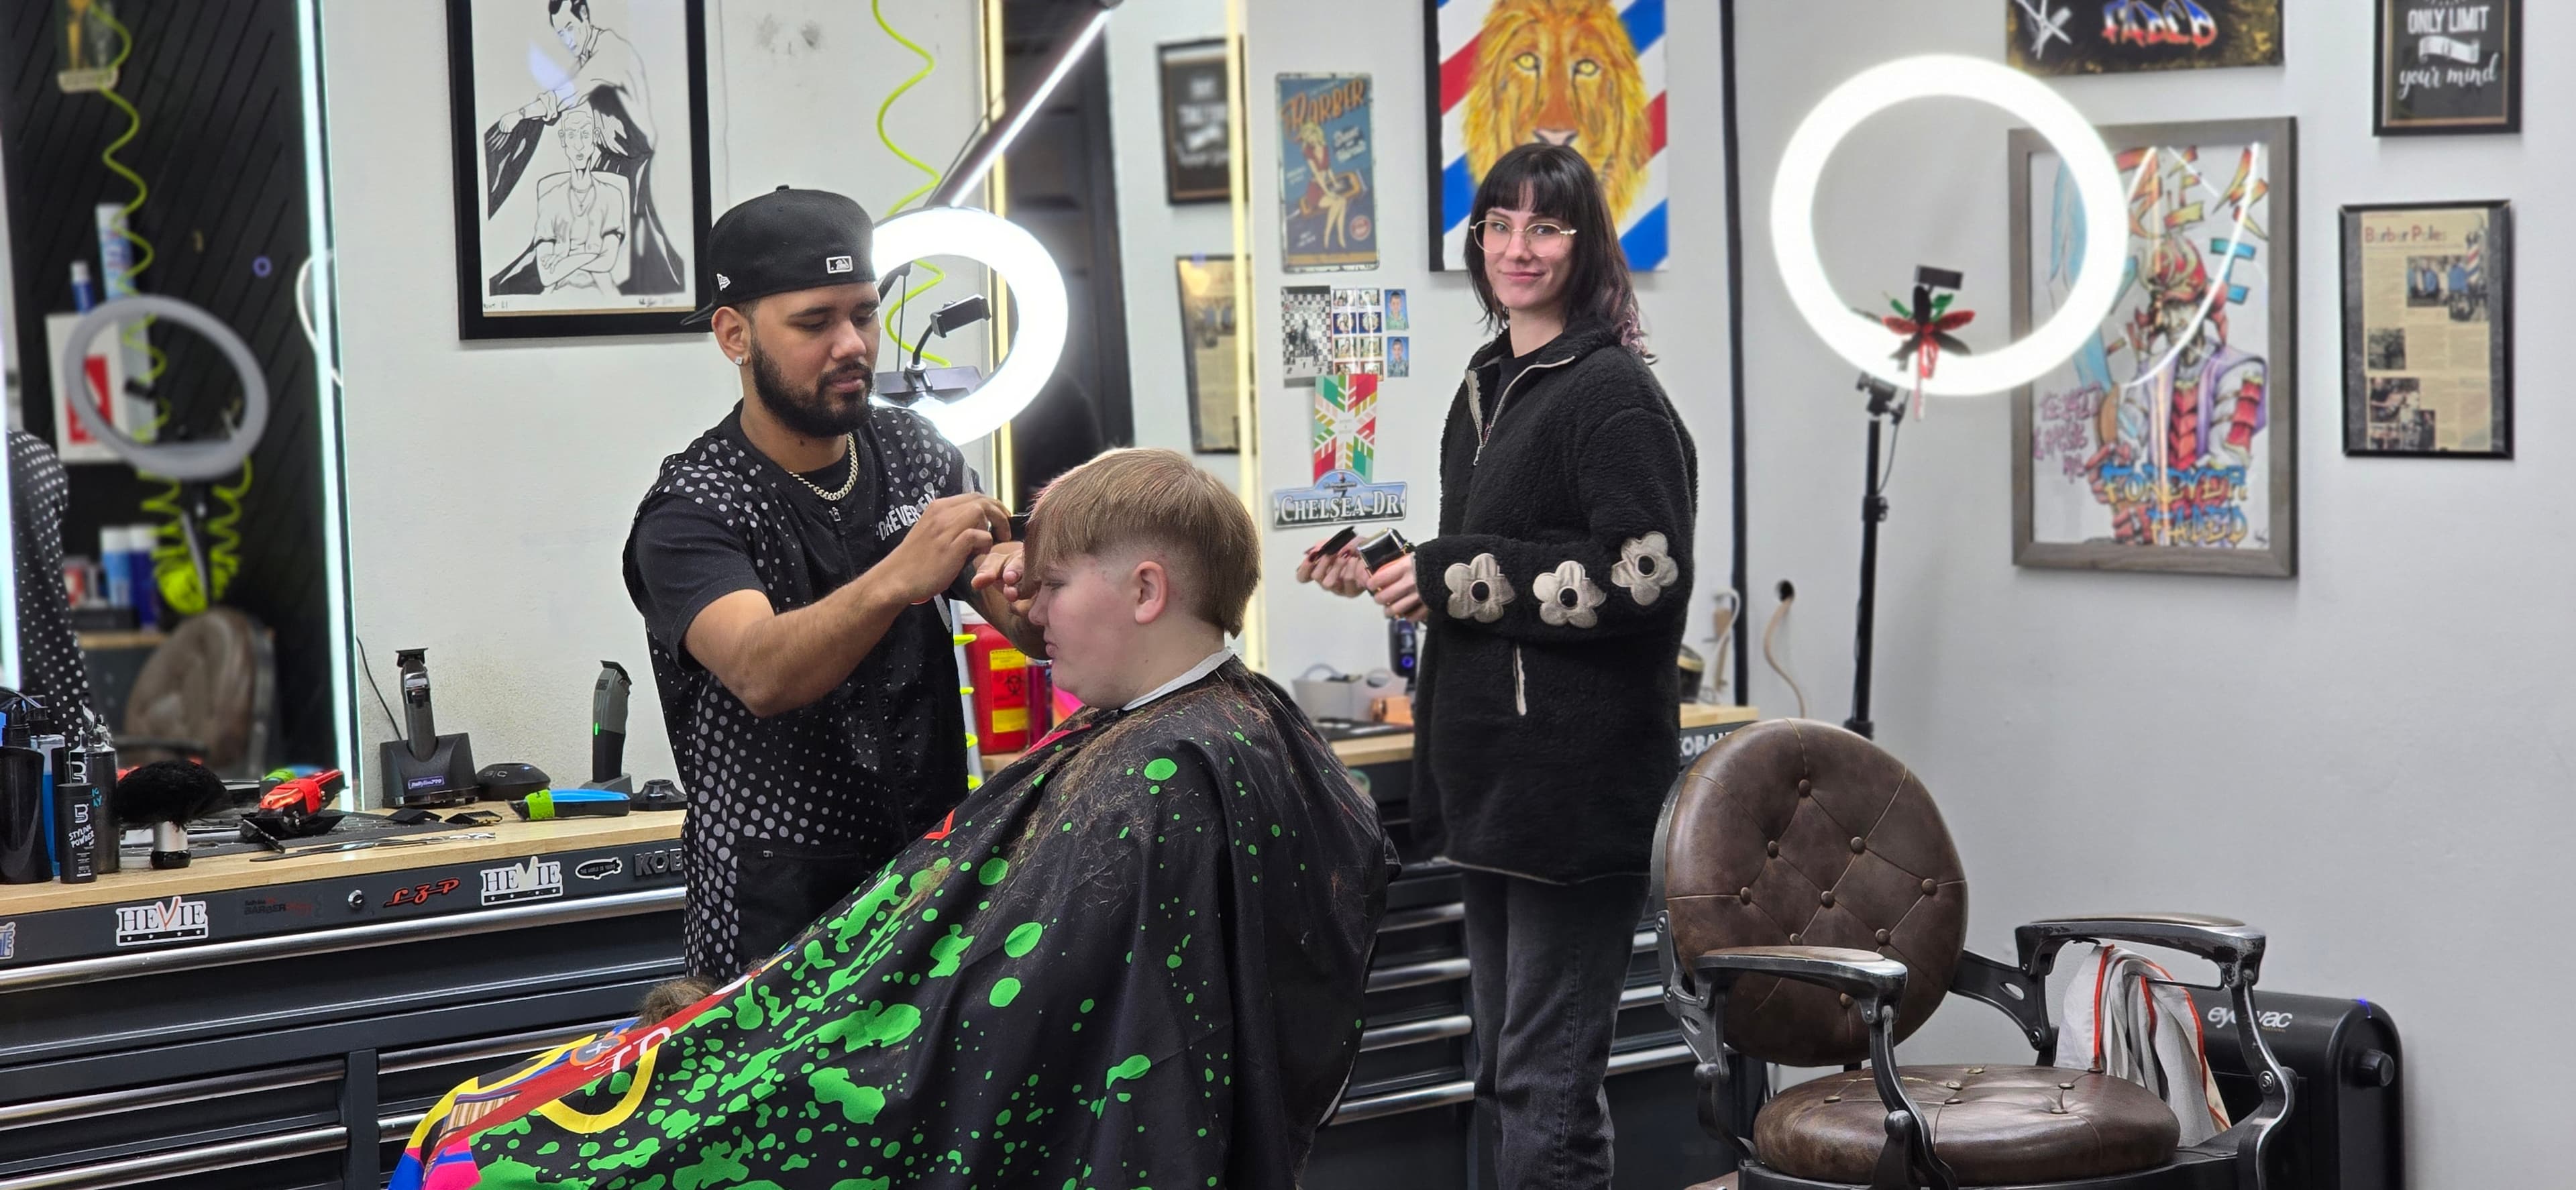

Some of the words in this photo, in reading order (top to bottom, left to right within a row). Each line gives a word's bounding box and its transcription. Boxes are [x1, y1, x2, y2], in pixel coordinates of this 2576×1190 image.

[2408, 8, 2446, 34] ONLY
[2449, 6, 2489, 33] LIMIT
[2398, 66, 2440, 99] your
[2447, 52, 2499, 87] mind
[1281, 495, 1364, 521] CHELSEA
[1373, 490, 1400, 515] DR
[120, 898, 206, 932] HEVIE
[2207, 1006, 2293, 1028] eyvac
